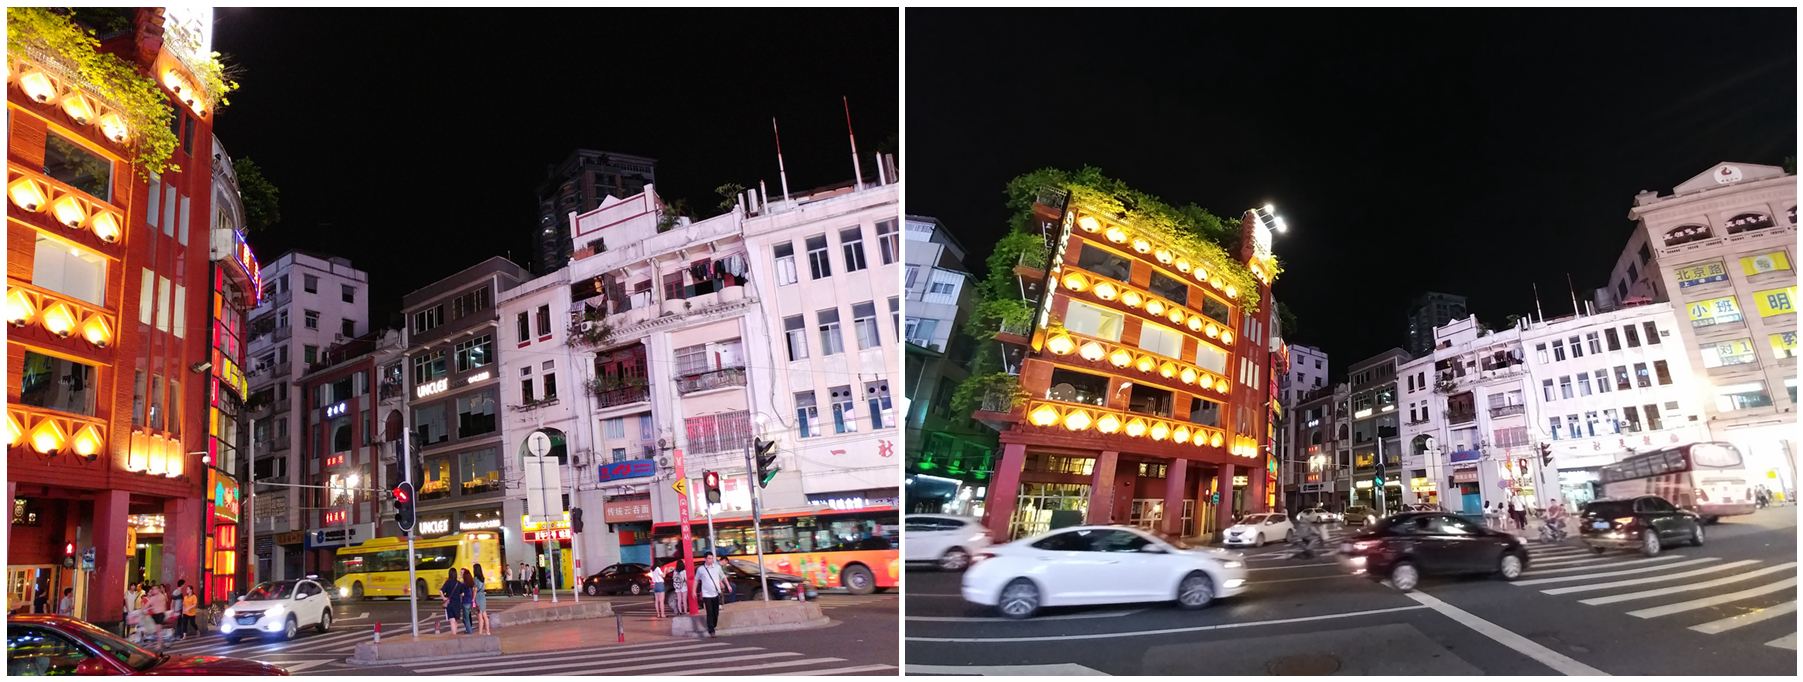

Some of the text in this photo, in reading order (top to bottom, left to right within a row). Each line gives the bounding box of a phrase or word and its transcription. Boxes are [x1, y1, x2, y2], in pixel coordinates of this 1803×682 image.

[1676, 265, 1722, 280] 北京路
[1767, 292, 1791, 310] 明
[607, 504, 649, 516] 传统云吞面
[681, 508, 690, 540] 北京路站
